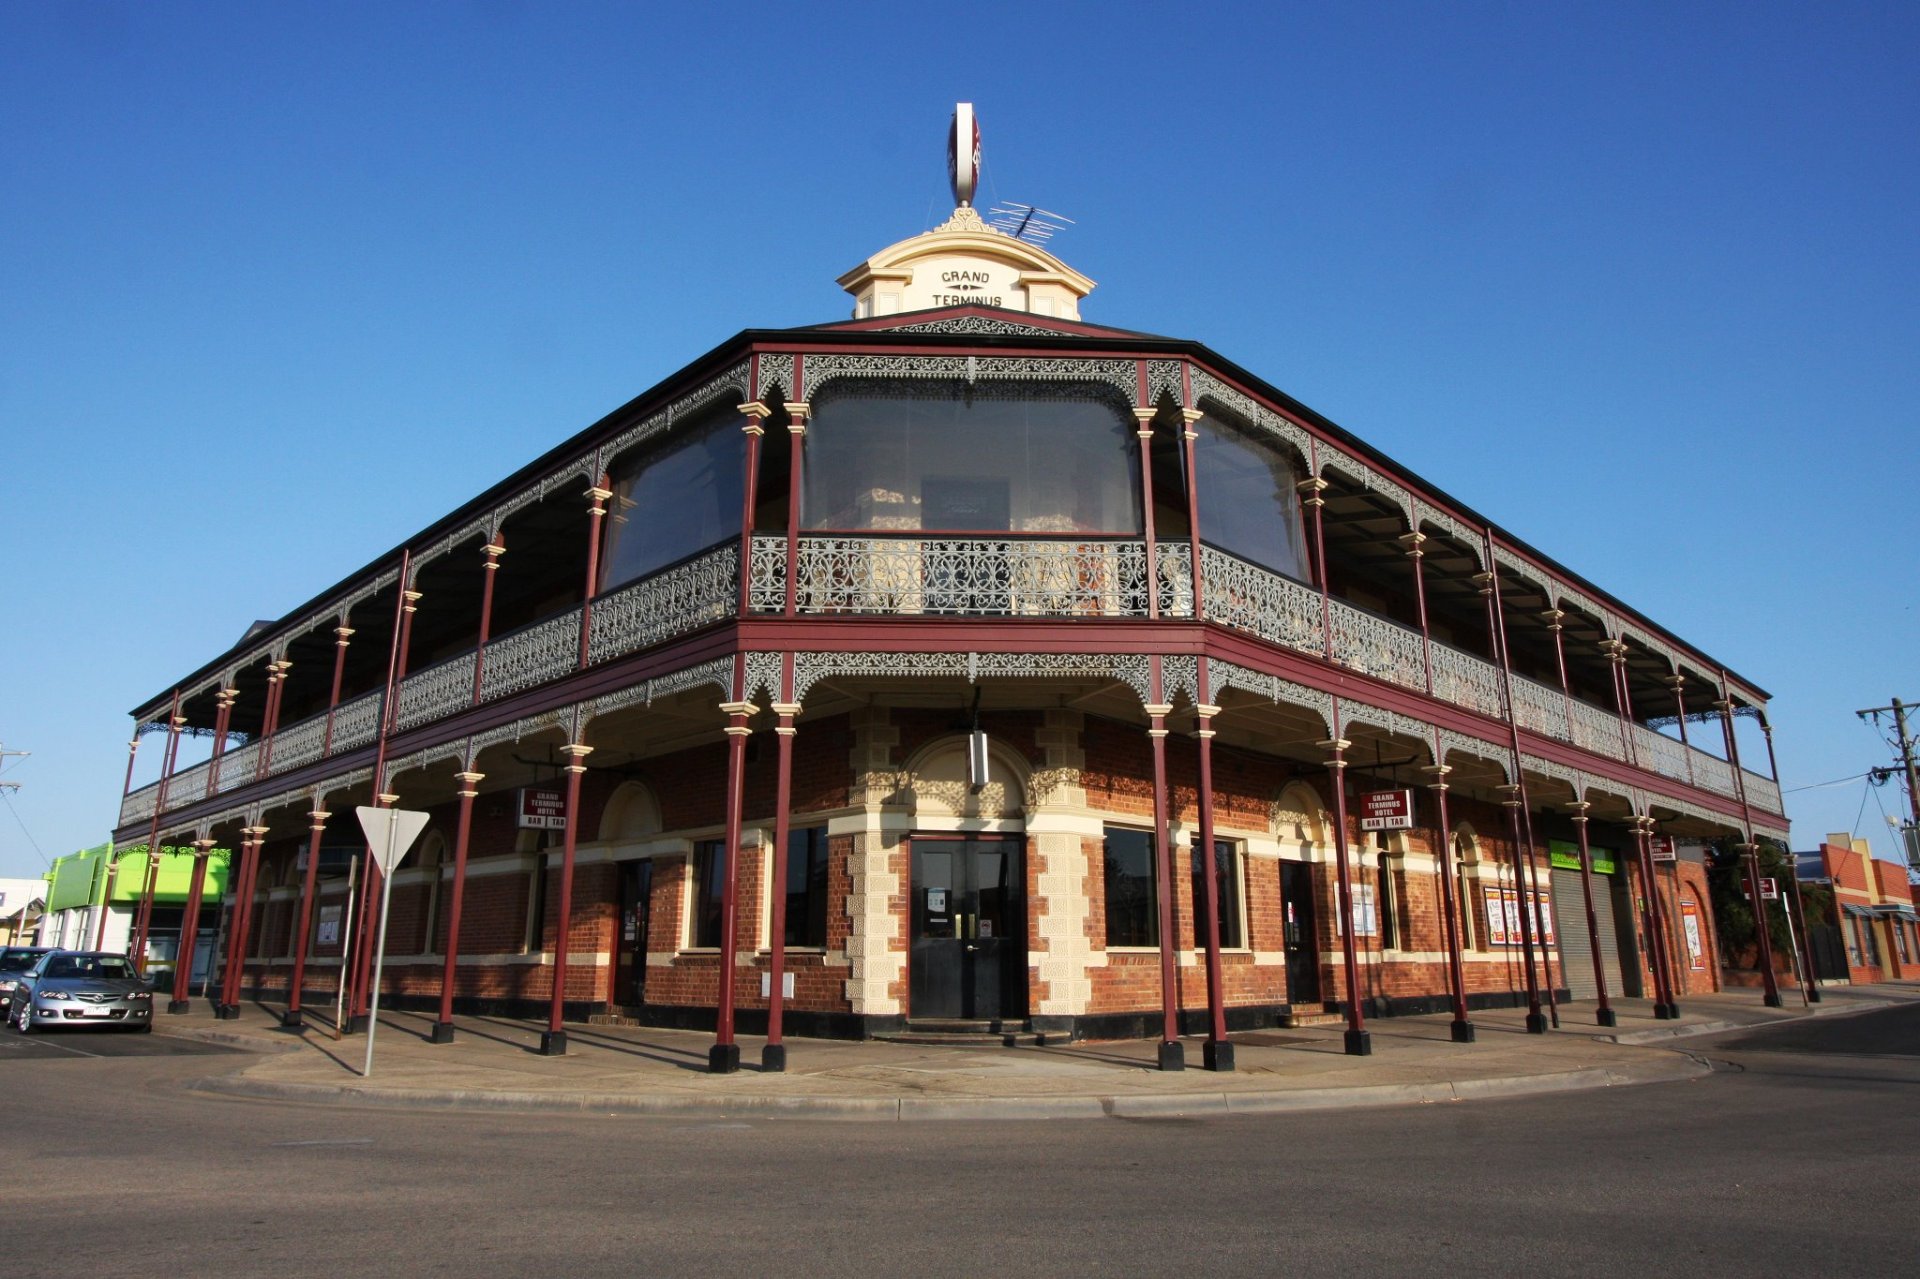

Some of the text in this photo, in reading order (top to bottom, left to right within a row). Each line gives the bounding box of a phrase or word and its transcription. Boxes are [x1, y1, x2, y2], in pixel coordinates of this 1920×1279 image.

[942, 271, 989, 283] GRAND
[933, 295, 1001, 306] TERMINUS
[536, 792, 559, 800] GRAND
[1372, 794, 1394, 802] GRAND
[531, 799, 564, 808] TERMINUS
[1367, 800, 1400, 809] TERMINUS
[537, 807, 556, 815] HOTEL
[1374, 808, 1394, 816] HOTEL
[552, 818, 564, 826] TAB
